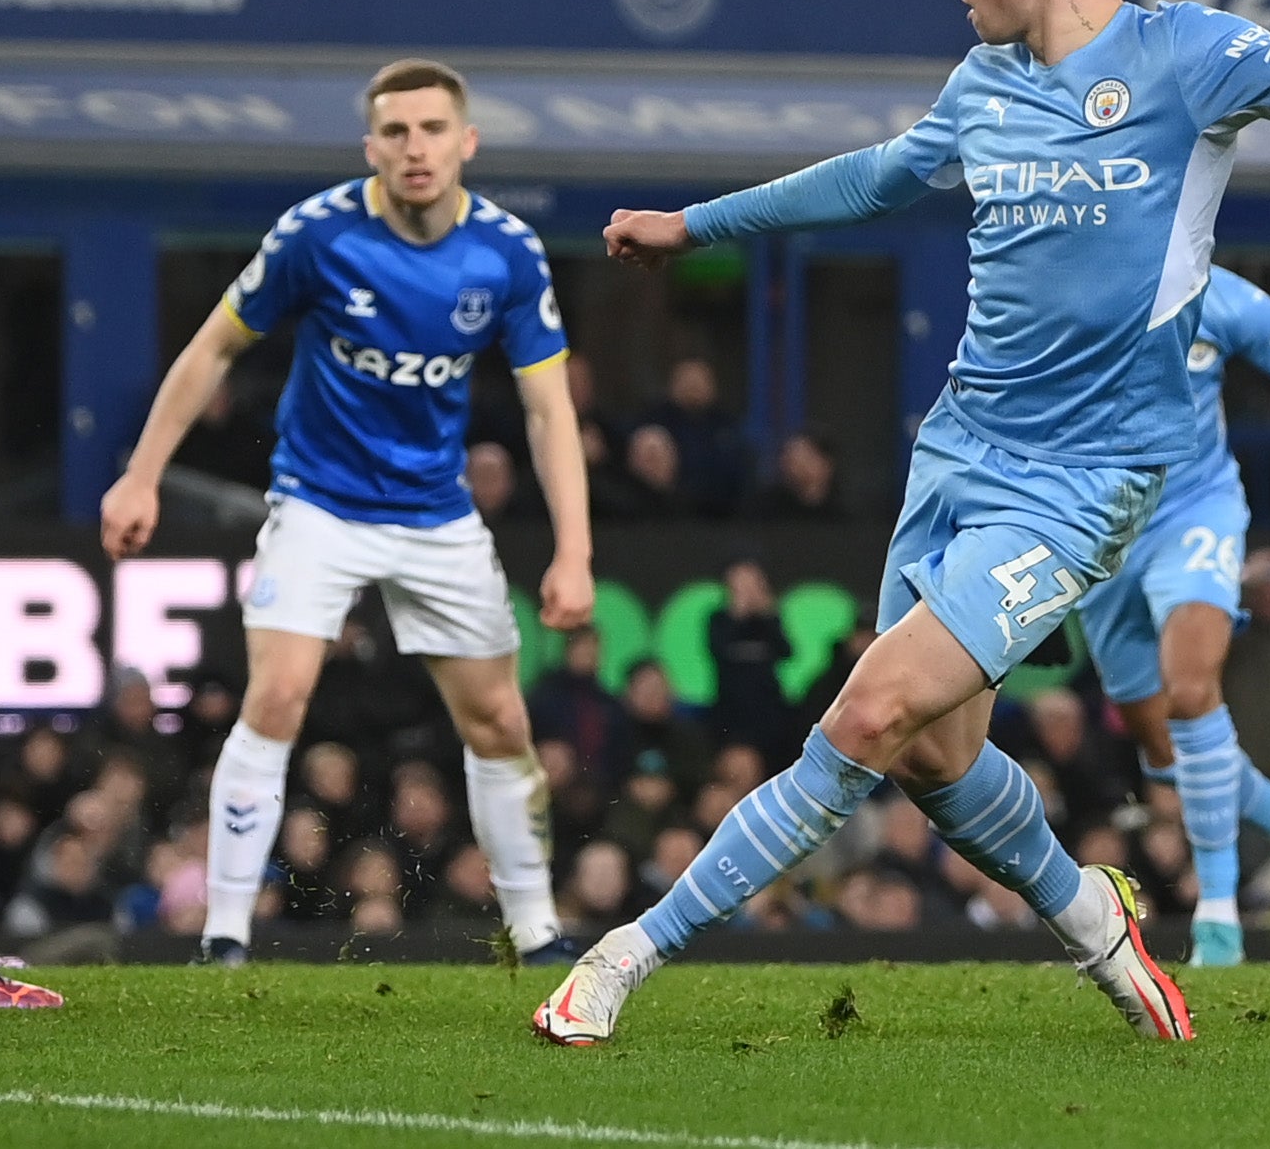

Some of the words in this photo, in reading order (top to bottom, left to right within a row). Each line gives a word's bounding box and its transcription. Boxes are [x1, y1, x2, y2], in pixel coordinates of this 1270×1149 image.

[970, 158, 1150, 197] ETIHAD
[987, 202, 1108, 227] AIRWAYS
[330, 337, 474, 388] CAZOO
[1182, 525, 1240, 582] 26
[989, 543, 1083, 629] 47
